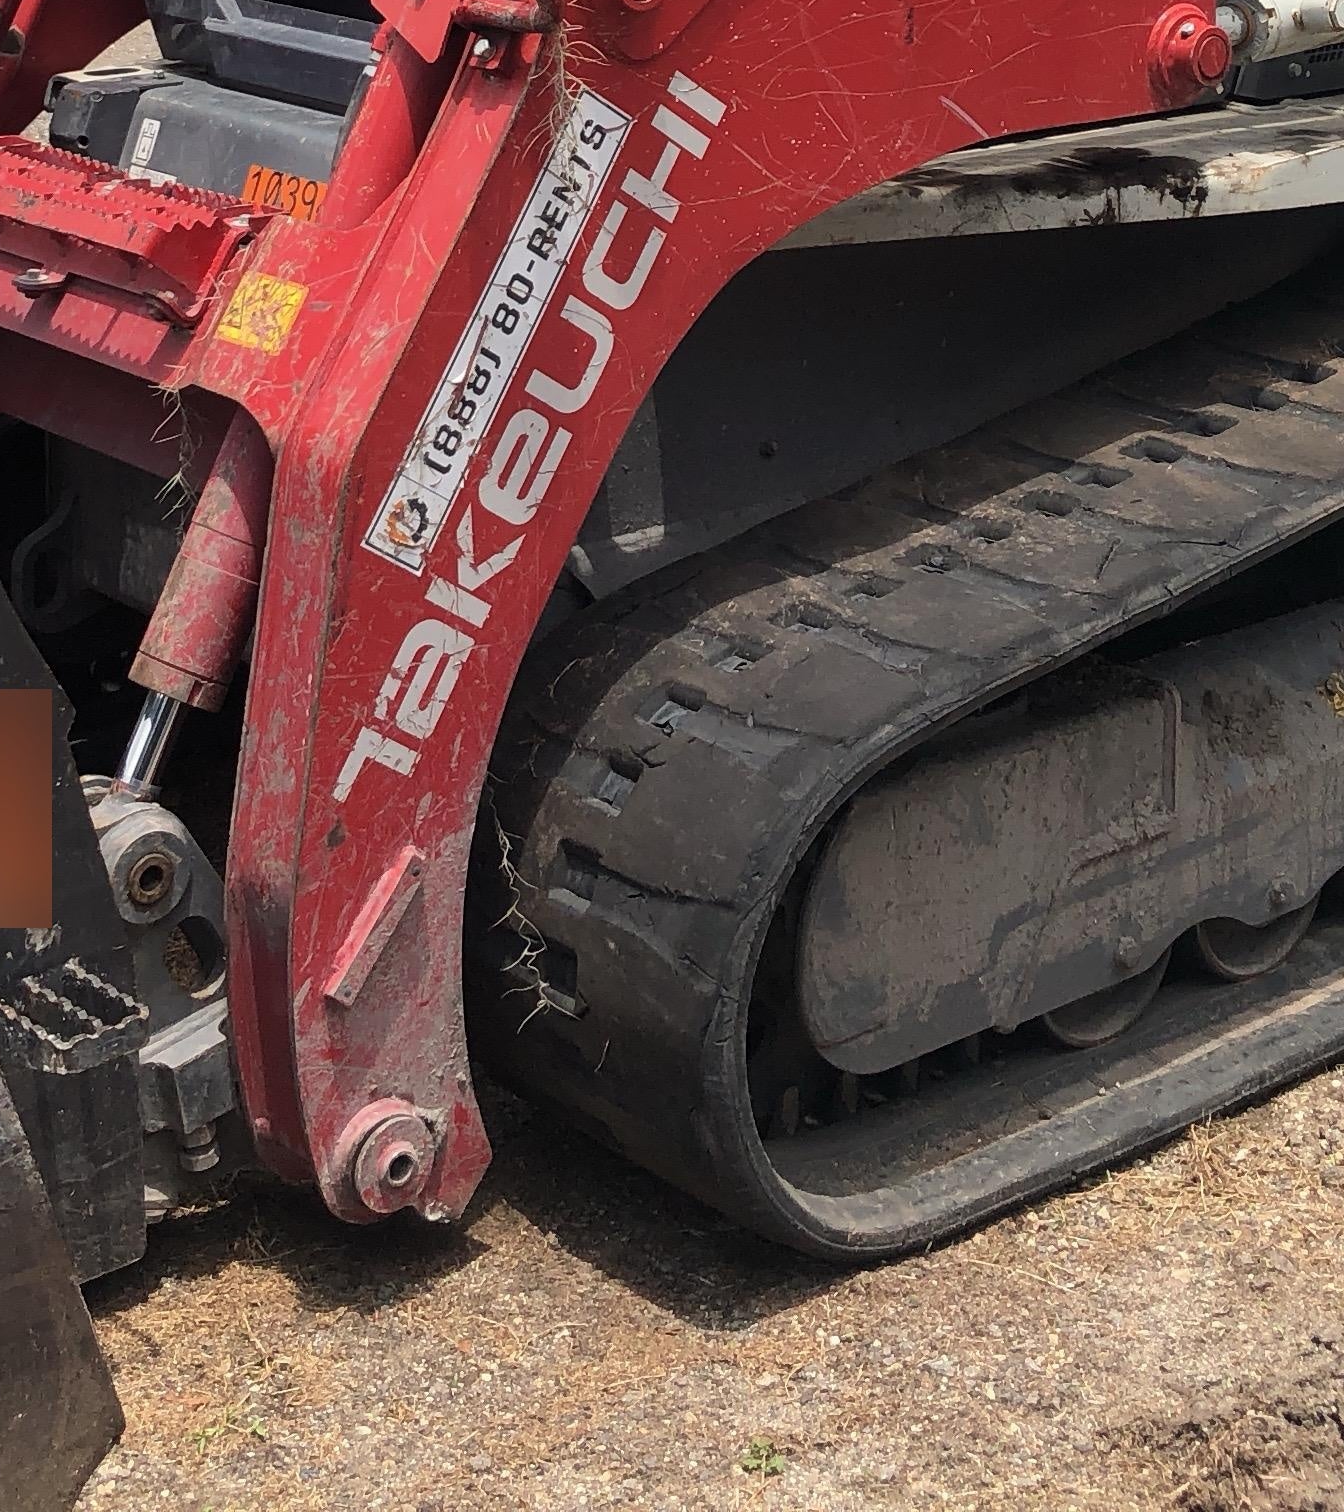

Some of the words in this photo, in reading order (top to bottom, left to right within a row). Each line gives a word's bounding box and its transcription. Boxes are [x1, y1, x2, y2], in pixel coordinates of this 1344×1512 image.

[251, 166, 320, 222] 1039
[422, 346, 503, 476] (888)
[491, 117, 608, 338] 80-RENTS
